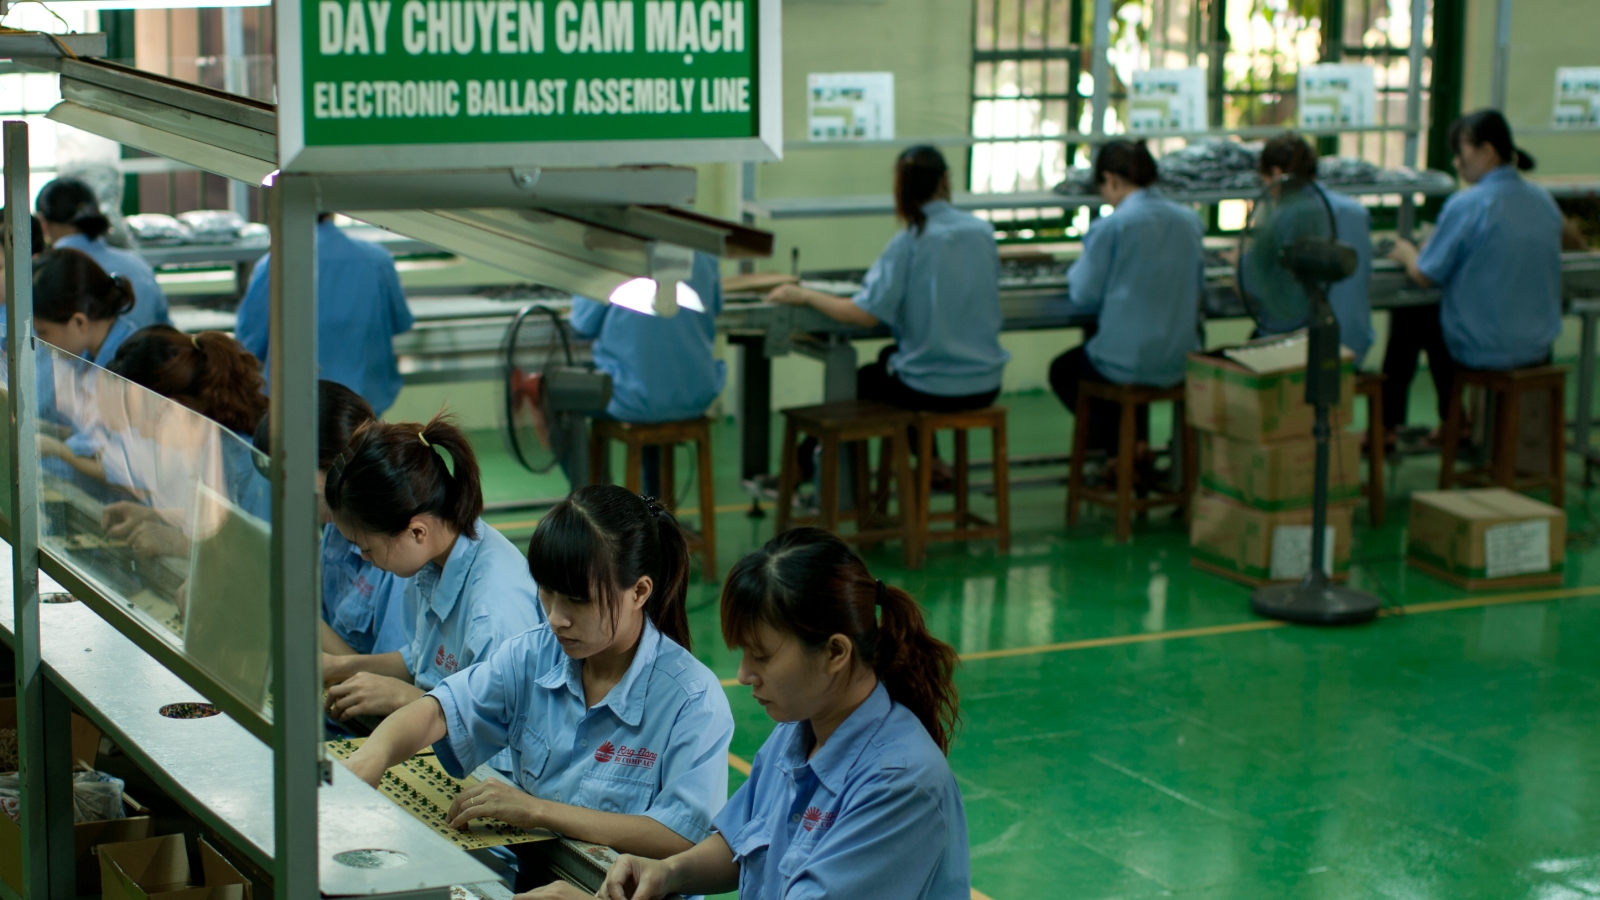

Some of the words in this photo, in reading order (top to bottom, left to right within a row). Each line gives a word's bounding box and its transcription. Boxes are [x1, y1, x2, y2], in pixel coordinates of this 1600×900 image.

[314, 81, 460, 119] ELECTRONIC
[466, 79, 567, 116] BALLAST
[573, 78, 695, 114] ASSEMBLY
[701, 77, 750, 113] LINE
[621, 757, 655, 768] COMPACT
